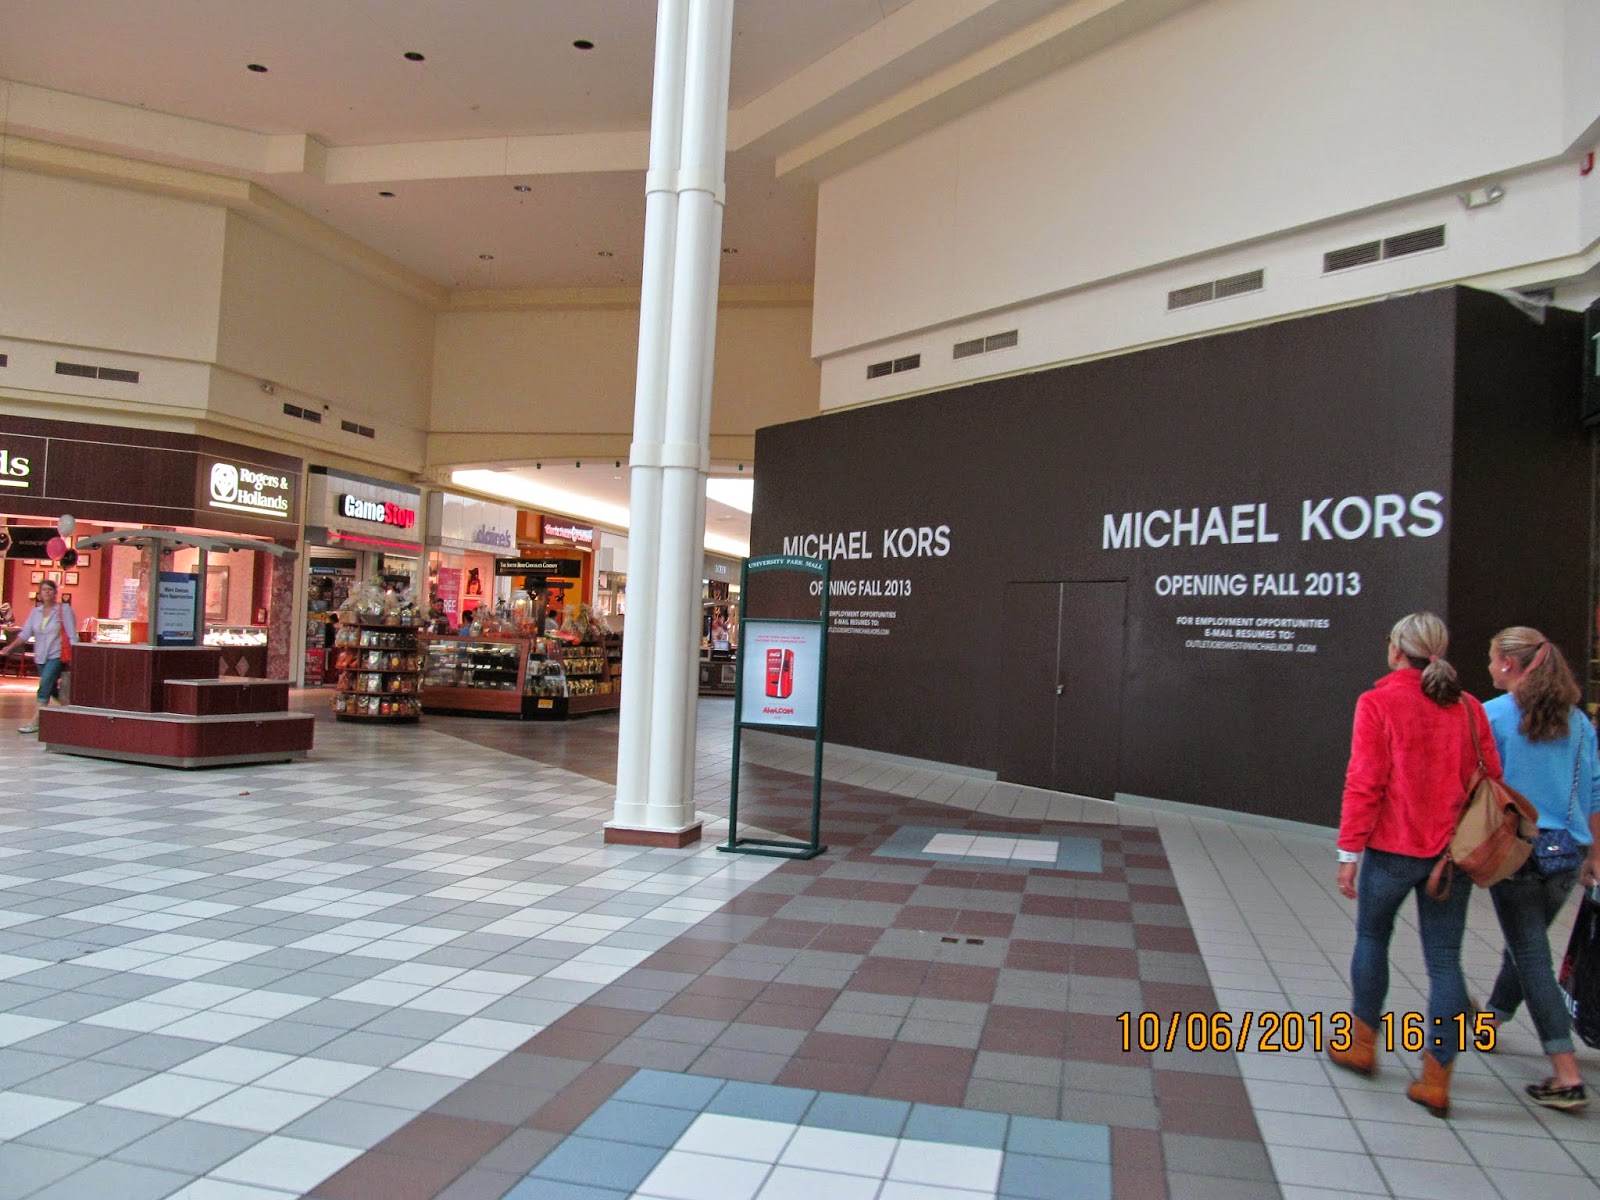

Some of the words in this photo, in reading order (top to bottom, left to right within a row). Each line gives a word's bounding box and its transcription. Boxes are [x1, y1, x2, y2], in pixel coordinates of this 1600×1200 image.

[240, 467, 279, 491] Rogers
[280, 477, 289, 490] &
[237, 489, 288, 510] Hollands
[344, 494, 415, 528] GameStop
[1101, 502, 1280, 549] MICHAEL
[1300, 491, 1445, 541] KORS
[782, 530, 873, 560] MICHAEL
[882, 525, 951, 558] KORS
[748, 559, 785, 569] UNIVERSITY
[805, 561, 823, 570] MALL
[809, 580, 857, 596] OPNING
[858, 580, 882, 596] FALL
[884, 579, 912, 596] 2013
[1155, 574, 1248, 597] OPENING
[1252, 573, 1300, 596] FALL
[1304, 571, 1362, 596] 2013
[1176, 616, 1194, 625] FOR
[1195, 616, 1255, 626] EMPLOYMENT
[1255, 618, 1330, 628] OPPORTUNITIES
[1204, 628, 1233, 637] E-MAIL
[1235, 629, 1276, 639] RESUMES
[1278, 630, 1295, 640] TO:
